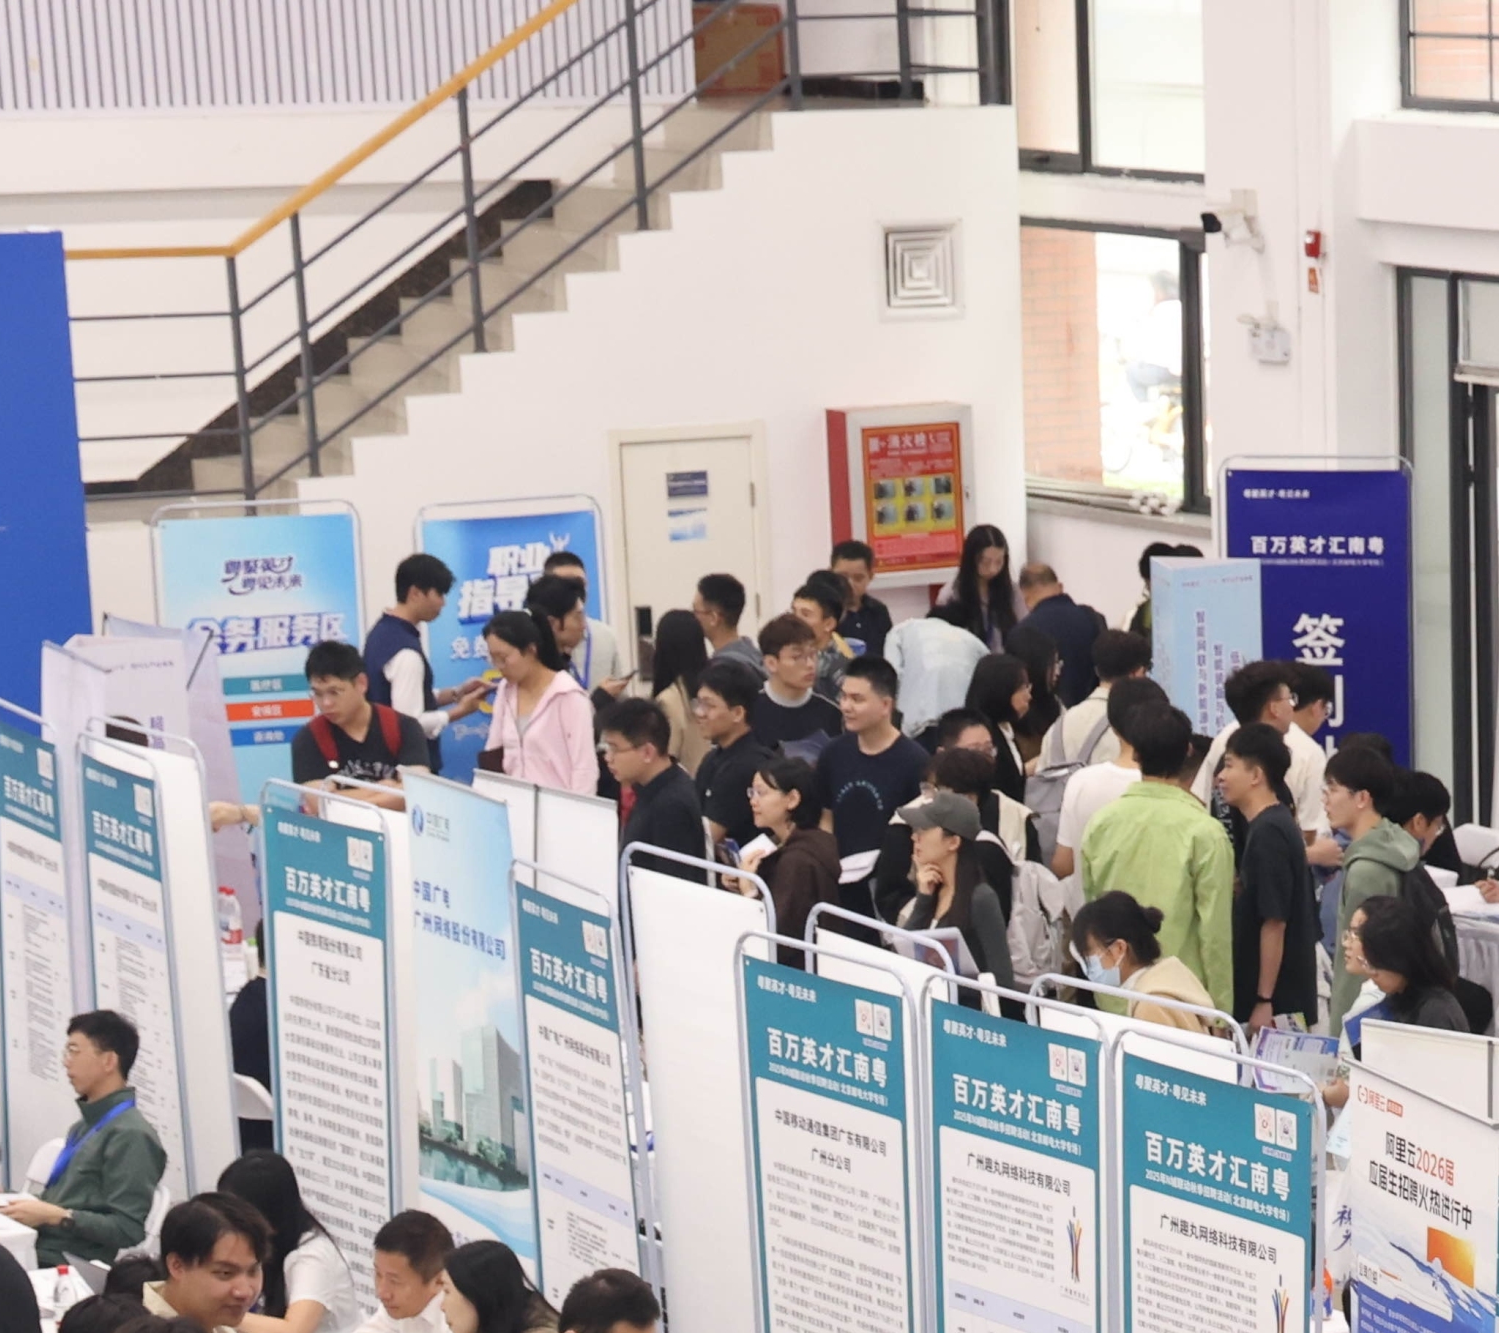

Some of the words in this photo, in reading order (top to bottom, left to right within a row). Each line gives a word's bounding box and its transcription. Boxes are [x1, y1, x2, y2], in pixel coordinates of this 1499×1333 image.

[1250, 535, 1385, 556] 百万英才汇南粤
[284, 866, 371, 914] 百万英才汇南粤
[412, 878, 451, 909] 中国广电
[413, 910, 507, 961] 广州网络股份有限公司
[529, 947, 609, 1005] 百万英才汇南粤
[767, 1026, 888, 1088] 百万英才汇南粤
[952, 1073, 1082, 1137] 百万英才汇南粤
[774, 1108, 888, 1157] 中国移动通信集团广东有限公司
[810, 1147, 852, 1174] 广州分公司
[1144, 1131, 1291, 1201] 百万英才汇南粤
[1384, 1130, 1455, 1188] 阿里云2026届
[1367, 1158, 1473, 1231] 应届生招聘火热进行中
[1159, 1213, 1278, 1264] 广州趣丸网络科技有限公司
